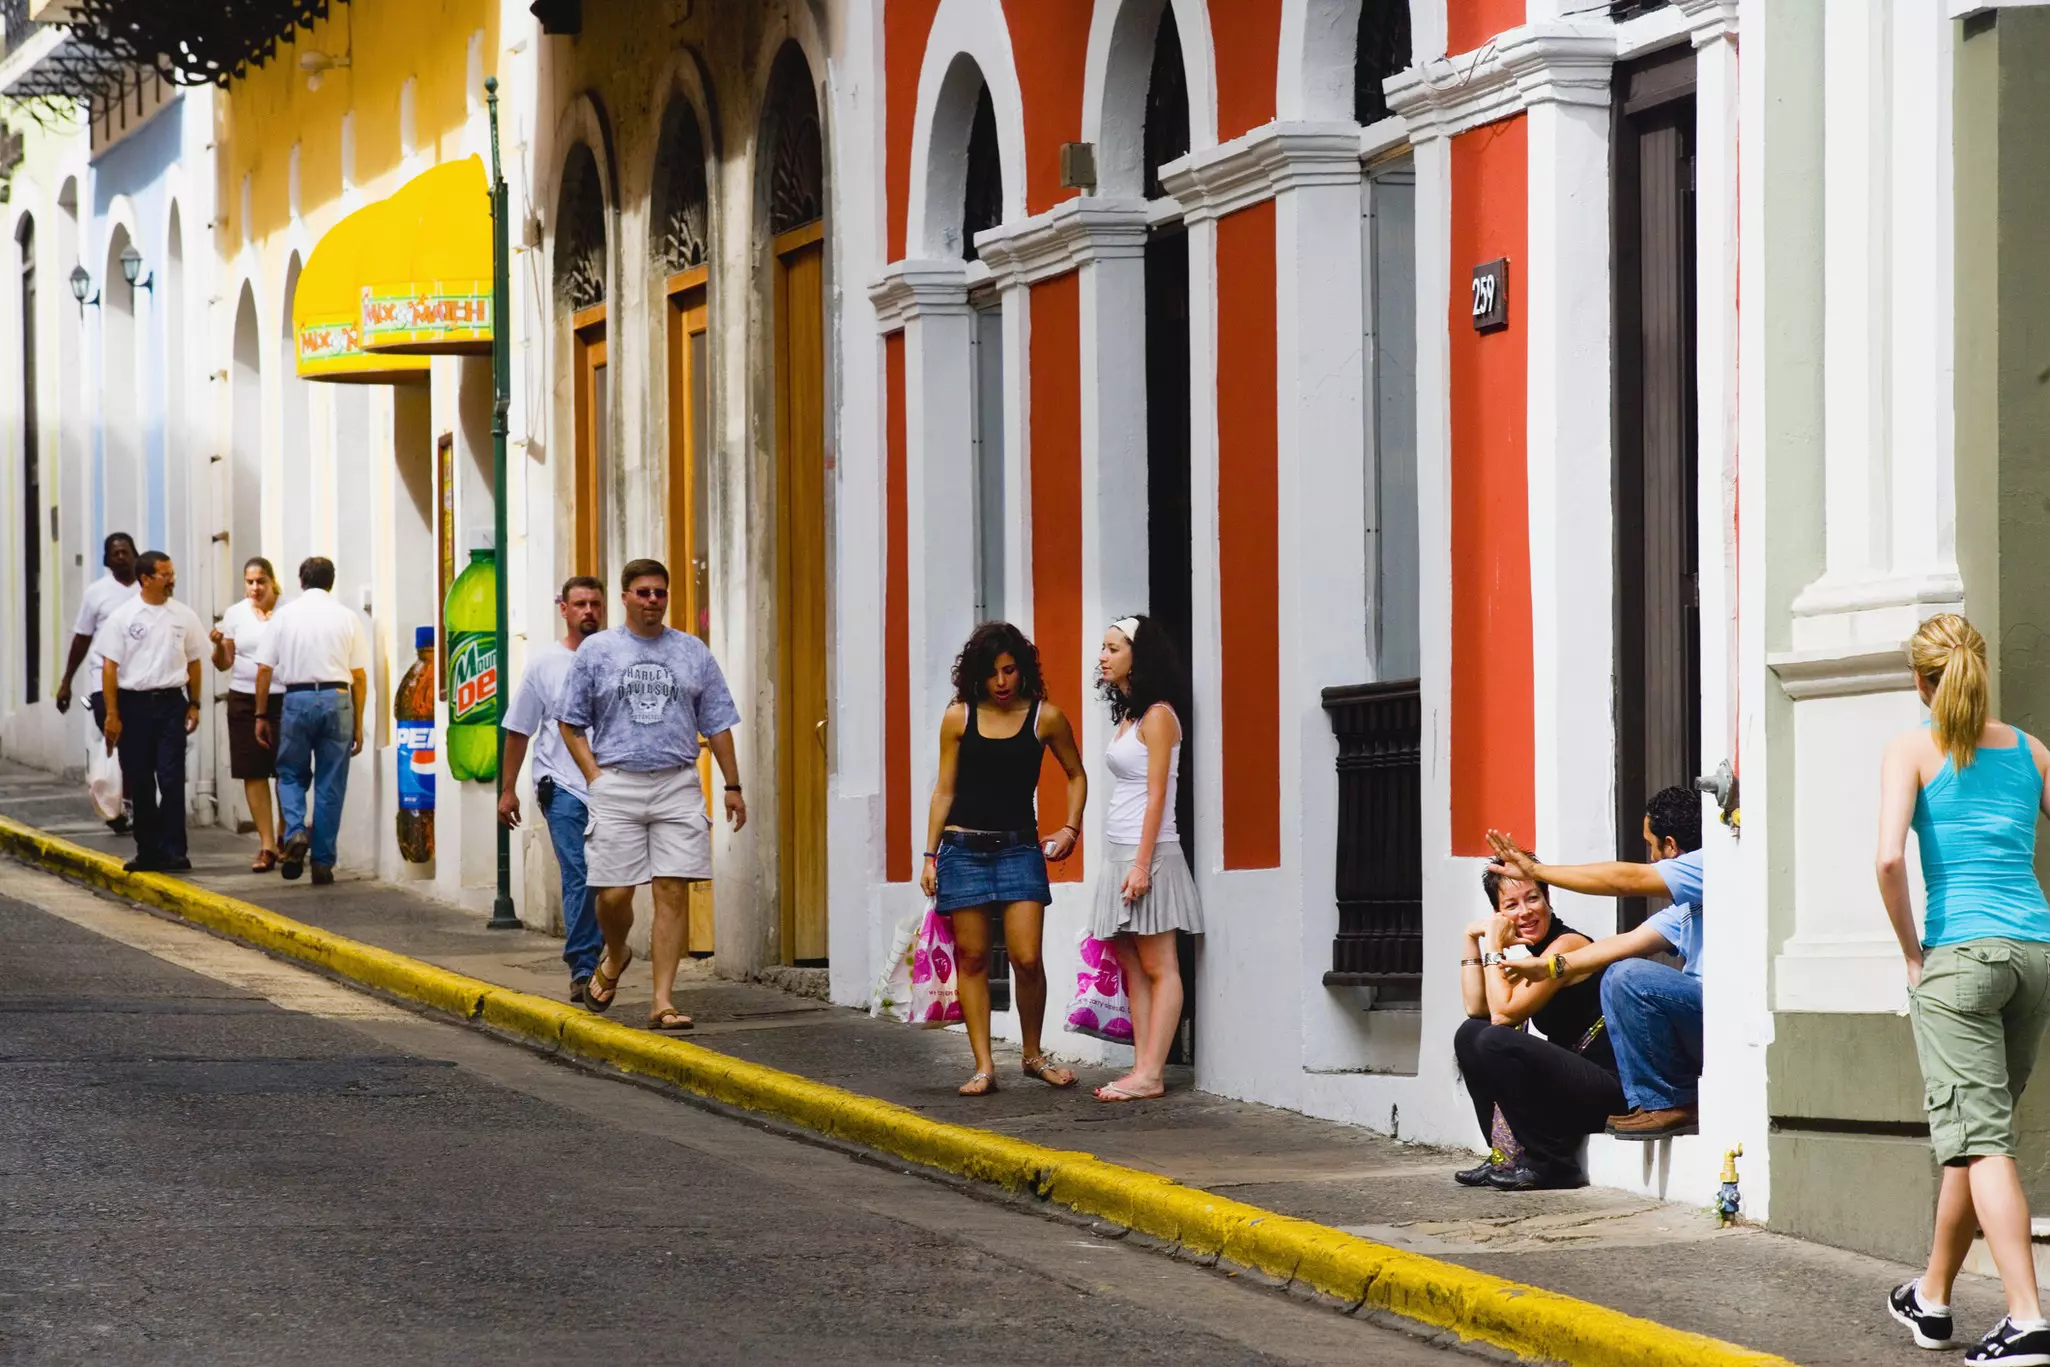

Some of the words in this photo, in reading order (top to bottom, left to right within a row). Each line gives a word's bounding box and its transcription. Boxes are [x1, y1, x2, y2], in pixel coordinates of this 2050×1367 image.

[1472, 274, 1495, 316] 259
[408, 297, 485, 326] MATCH
[455, 642, 497, 700] Moun
[627, 667, 669, 681] HARLEY
[457, 668, 497, 713] De
[618, 683, 679, 702] DAVIDSON
[397, 728, 435, 749] PE
